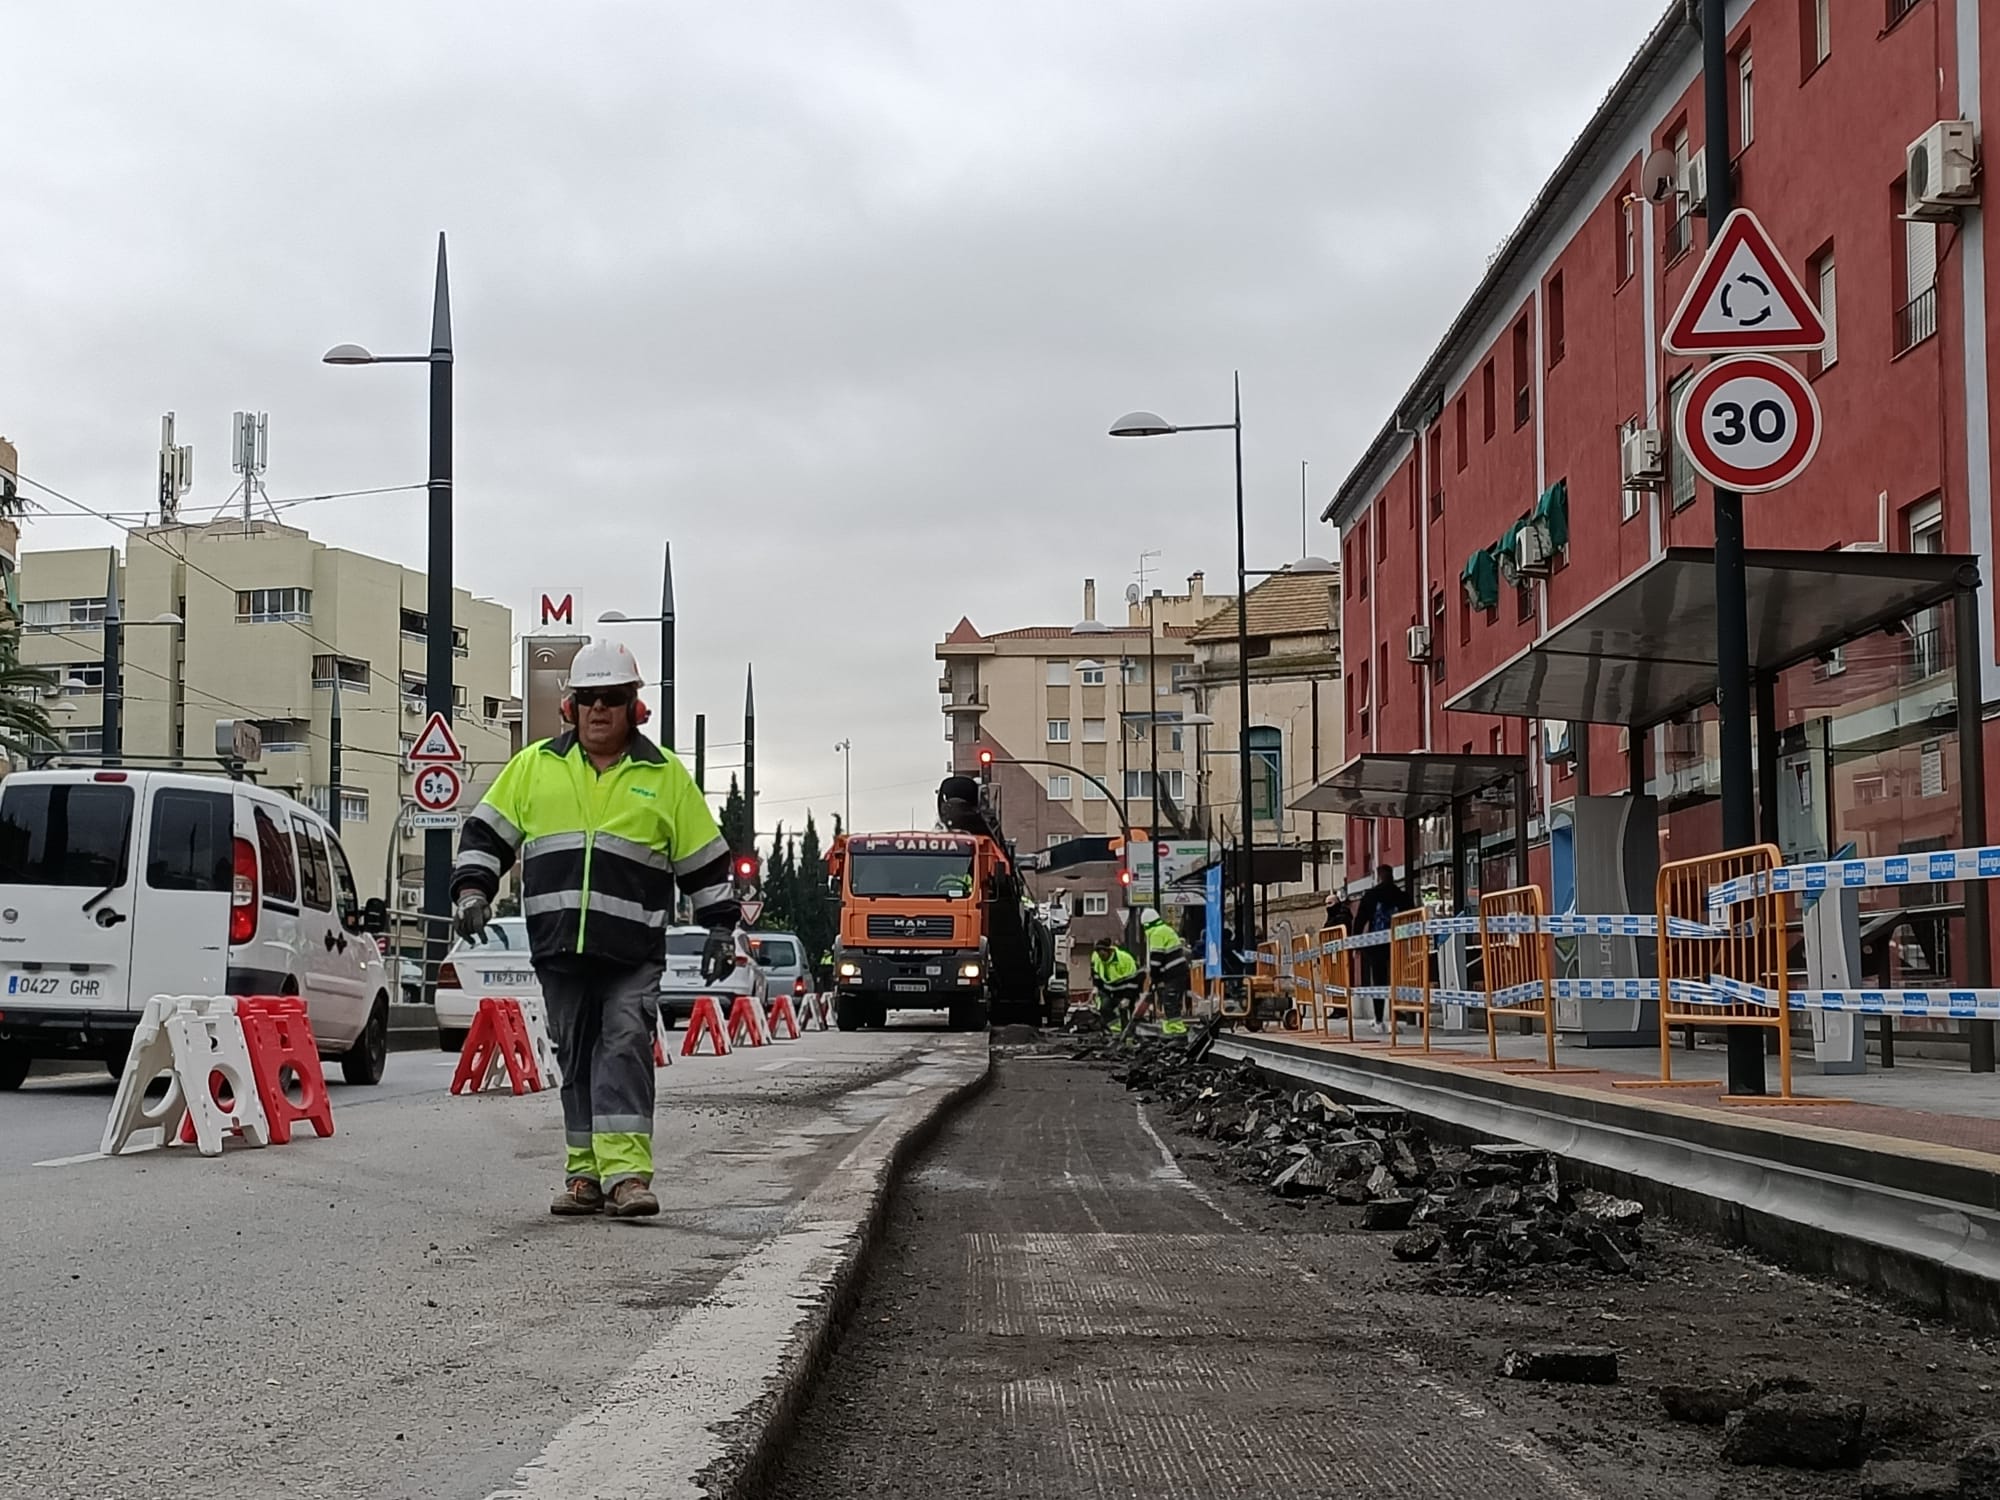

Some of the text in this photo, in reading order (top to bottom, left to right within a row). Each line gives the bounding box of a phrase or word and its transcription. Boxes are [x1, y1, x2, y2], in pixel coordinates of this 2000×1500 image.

[1711, 400, 1786, 445] 30
[541, 593, 572, 625] M
[895, 839, 958, 851] GARCIA
[894, 919, 927, 928] MAN
[20, 978, 100, 996] 0427 GHR
